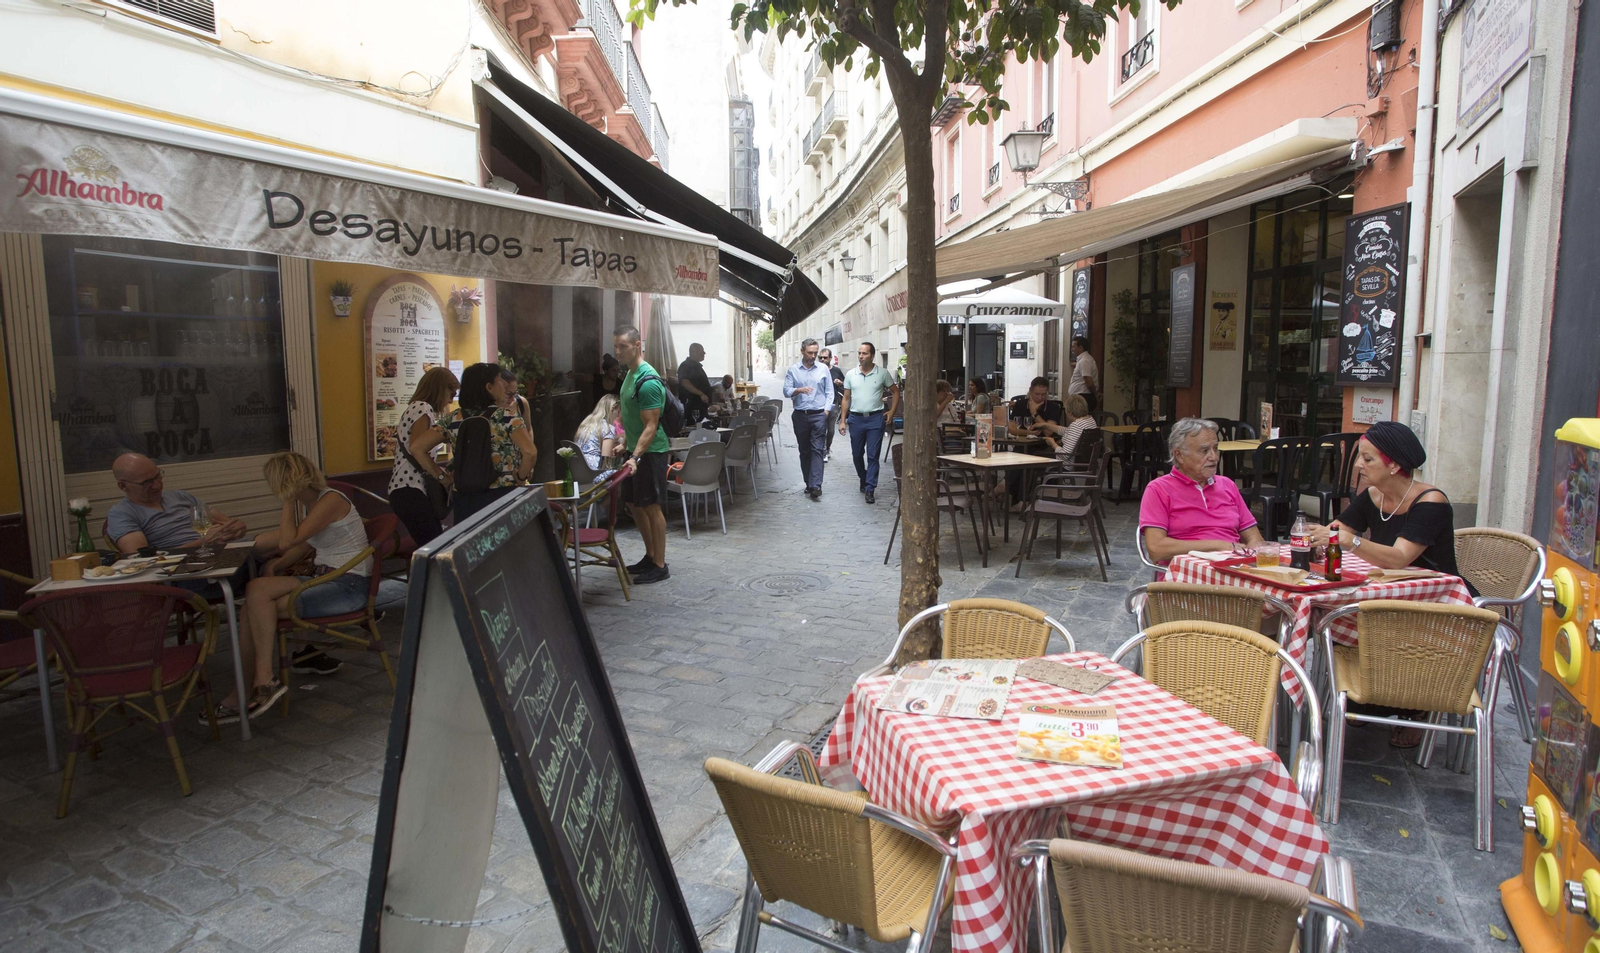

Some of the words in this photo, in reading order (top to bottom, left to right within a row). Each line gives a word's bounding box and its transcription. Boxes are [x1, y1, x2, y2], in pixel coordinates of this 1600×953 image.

[16, 168, 164, 211] Alhambra
[44, 208, 154, 227] CERVEZAS
[262, 188, 523, 258] Desayunos
[552, 237, 638, 280] Tapas
[675, 264, 708, 282] Alhambra
[1361, 276, 1374, 284] TAPAS
[391, 284, 407, 295] TAPAS
[412, 285, 431, 300] PAELLAS
[1362, 283, 1380, 291] SEVILLA
[388, 294, 406, 305] CARNES
[412, 294, 433, 312] PESCADOS
[400, 302, 417, 312] BOCA
[966, 303, 1053, 317] Cruzcampo
[383, 326, 405, 334] RISOTTI
[412, 328, 440, 336] SPAGHETTI
[400, 319, 418, 328] BOCA
[139, 367, 210, 397] BOCA
[1360, 396, 1385, 405] Cruzcampo
[170, 396, 188, 425] A
[144, 427, 215, 459] BOCA
[1058, 707, 1107, 715] POMODORO
